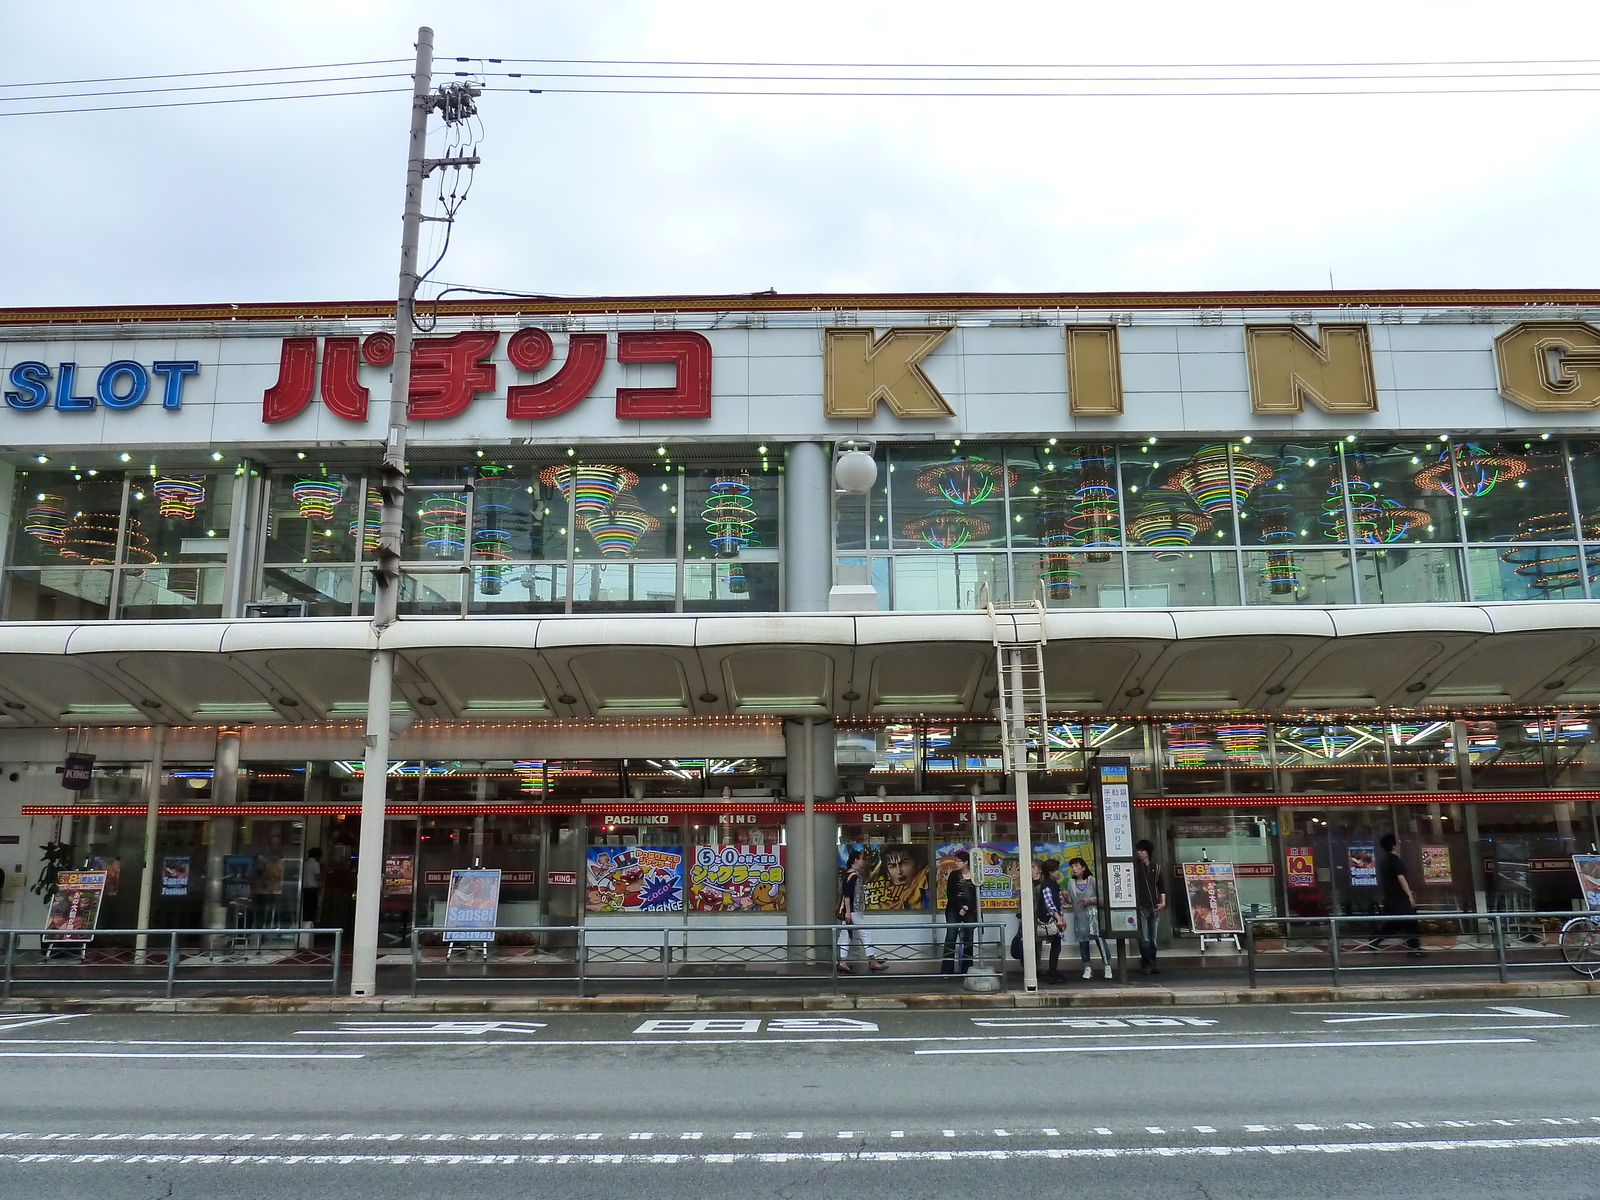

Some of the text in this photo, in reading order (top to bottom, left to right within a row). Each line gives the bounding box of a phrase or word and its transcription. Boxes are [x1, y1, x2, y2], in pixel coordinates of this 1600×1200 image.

[262, 327, 713, 423] パチンコ
[823, 319, 1600, 419] KING
[4, 359, 201, 412] SLOT
[1112, 788, 1121, 821] 動物園
[1120, 788, 1128, 821] 銀閣寺
[604, 815, 757, 824] PACHINKO KING
[862, 813, 902, 822] SLOT
[960, 812, 997, 821] KNG
[1042, 811, 1092, 820] PACHIN
[1113, 827, 1122, 851] のりば
[554, 875, 571, 883] KING
[690, 866, 783, 884] ジャグラーの日
[647, 883, 672, 902] GOGO!
[450, 906, 493, 922] Sansei
